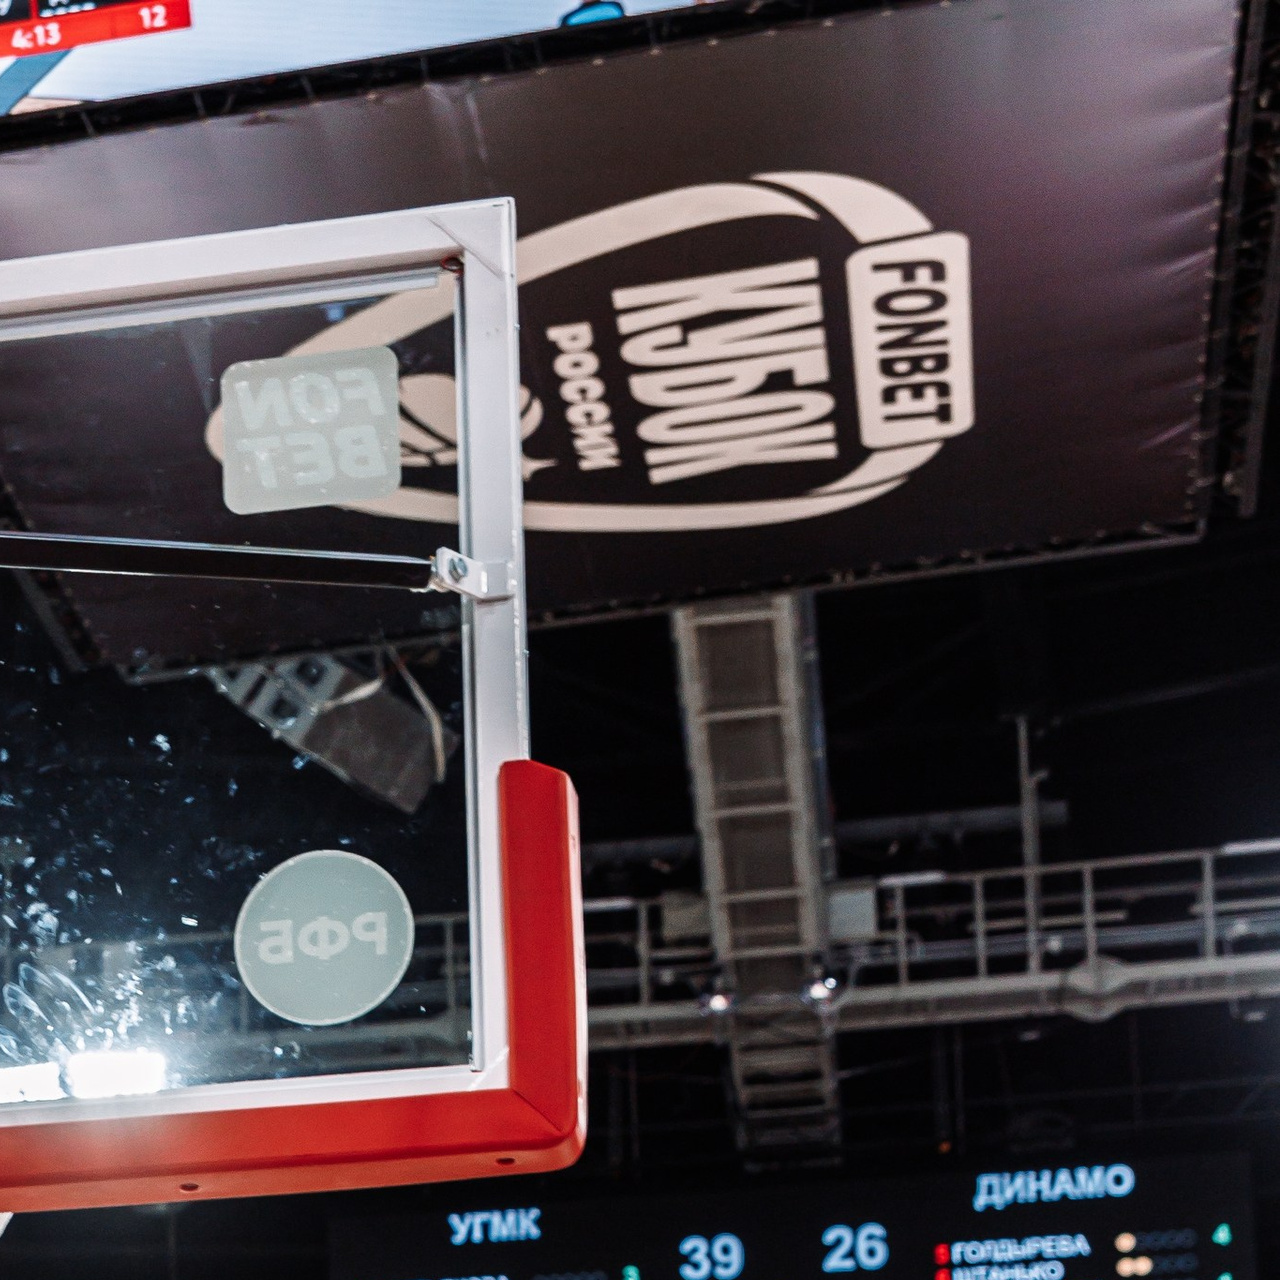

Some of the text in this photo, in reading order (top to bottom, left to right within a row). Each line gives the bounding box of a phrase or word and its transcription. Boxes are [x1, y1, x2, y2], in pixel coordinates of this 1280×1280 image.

[11, 22, 61, 49] 4:13
[138, 5, 167, 29] 12
[872, 257, 951, 426] FONBET
[546, 321, 621, 472] РОССИИ
[612, 257, 838, 485] КУБОК
[973, 1163, 1136, 1212] ДИНАМО
[448, 1208, 542, 1246] УГМК
[821, 1221, 890, 1274] 26
